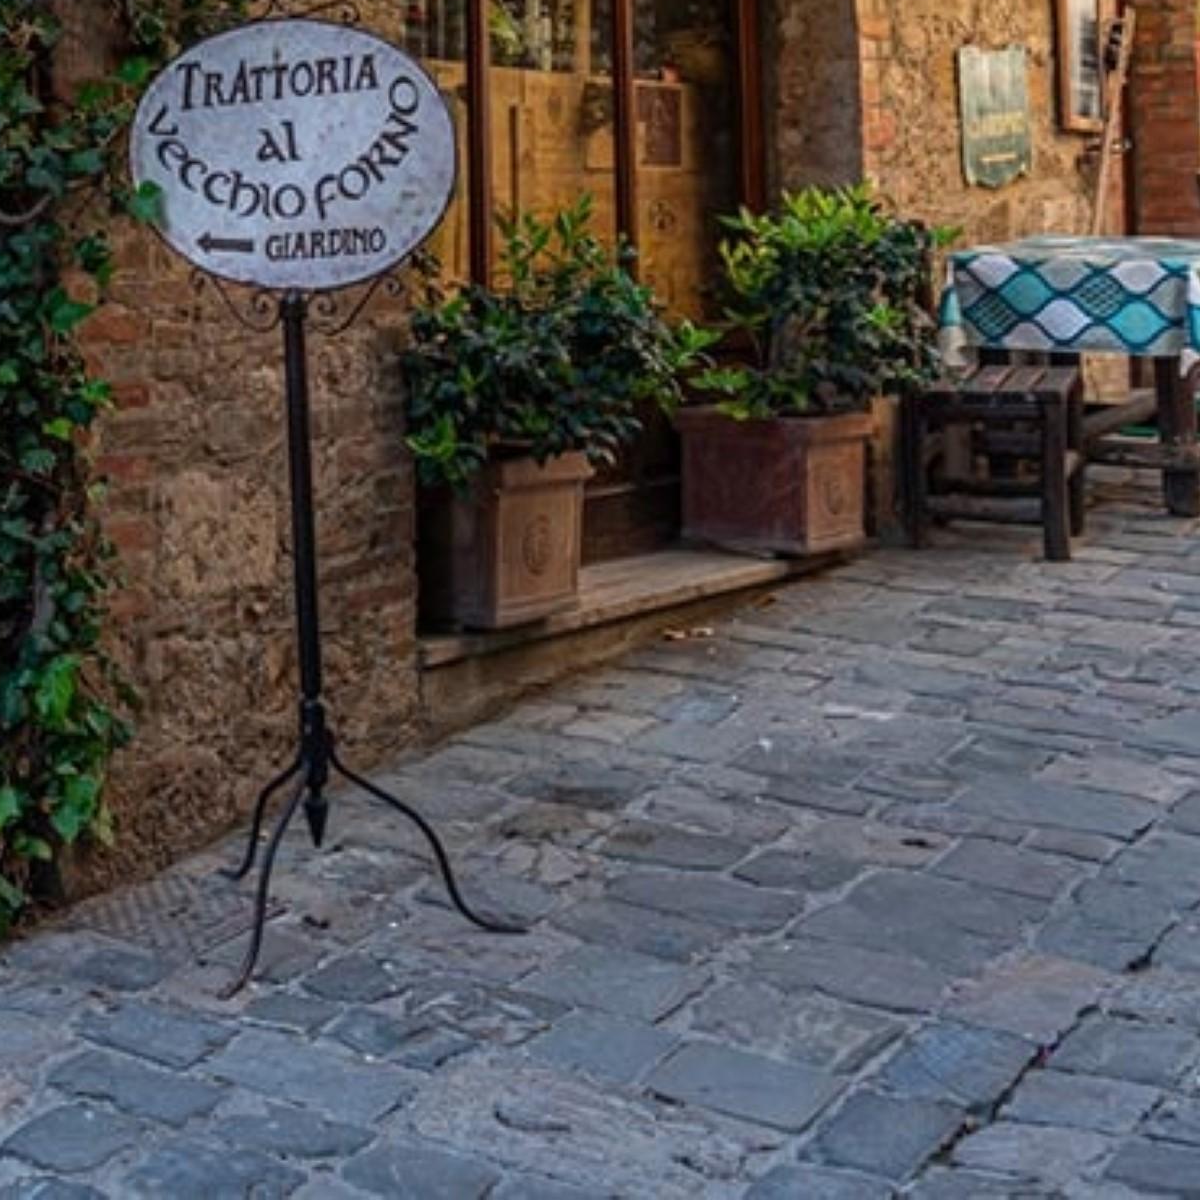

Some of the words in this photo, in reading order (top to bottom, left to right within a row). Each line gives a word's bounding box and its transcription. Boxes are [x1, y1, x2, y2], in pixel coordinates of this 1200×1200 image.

[176, 48, 382, 111] TRATTORIA
[256, 121, 302, 164] al
[265, 226, 388, 262] GIARDINO
